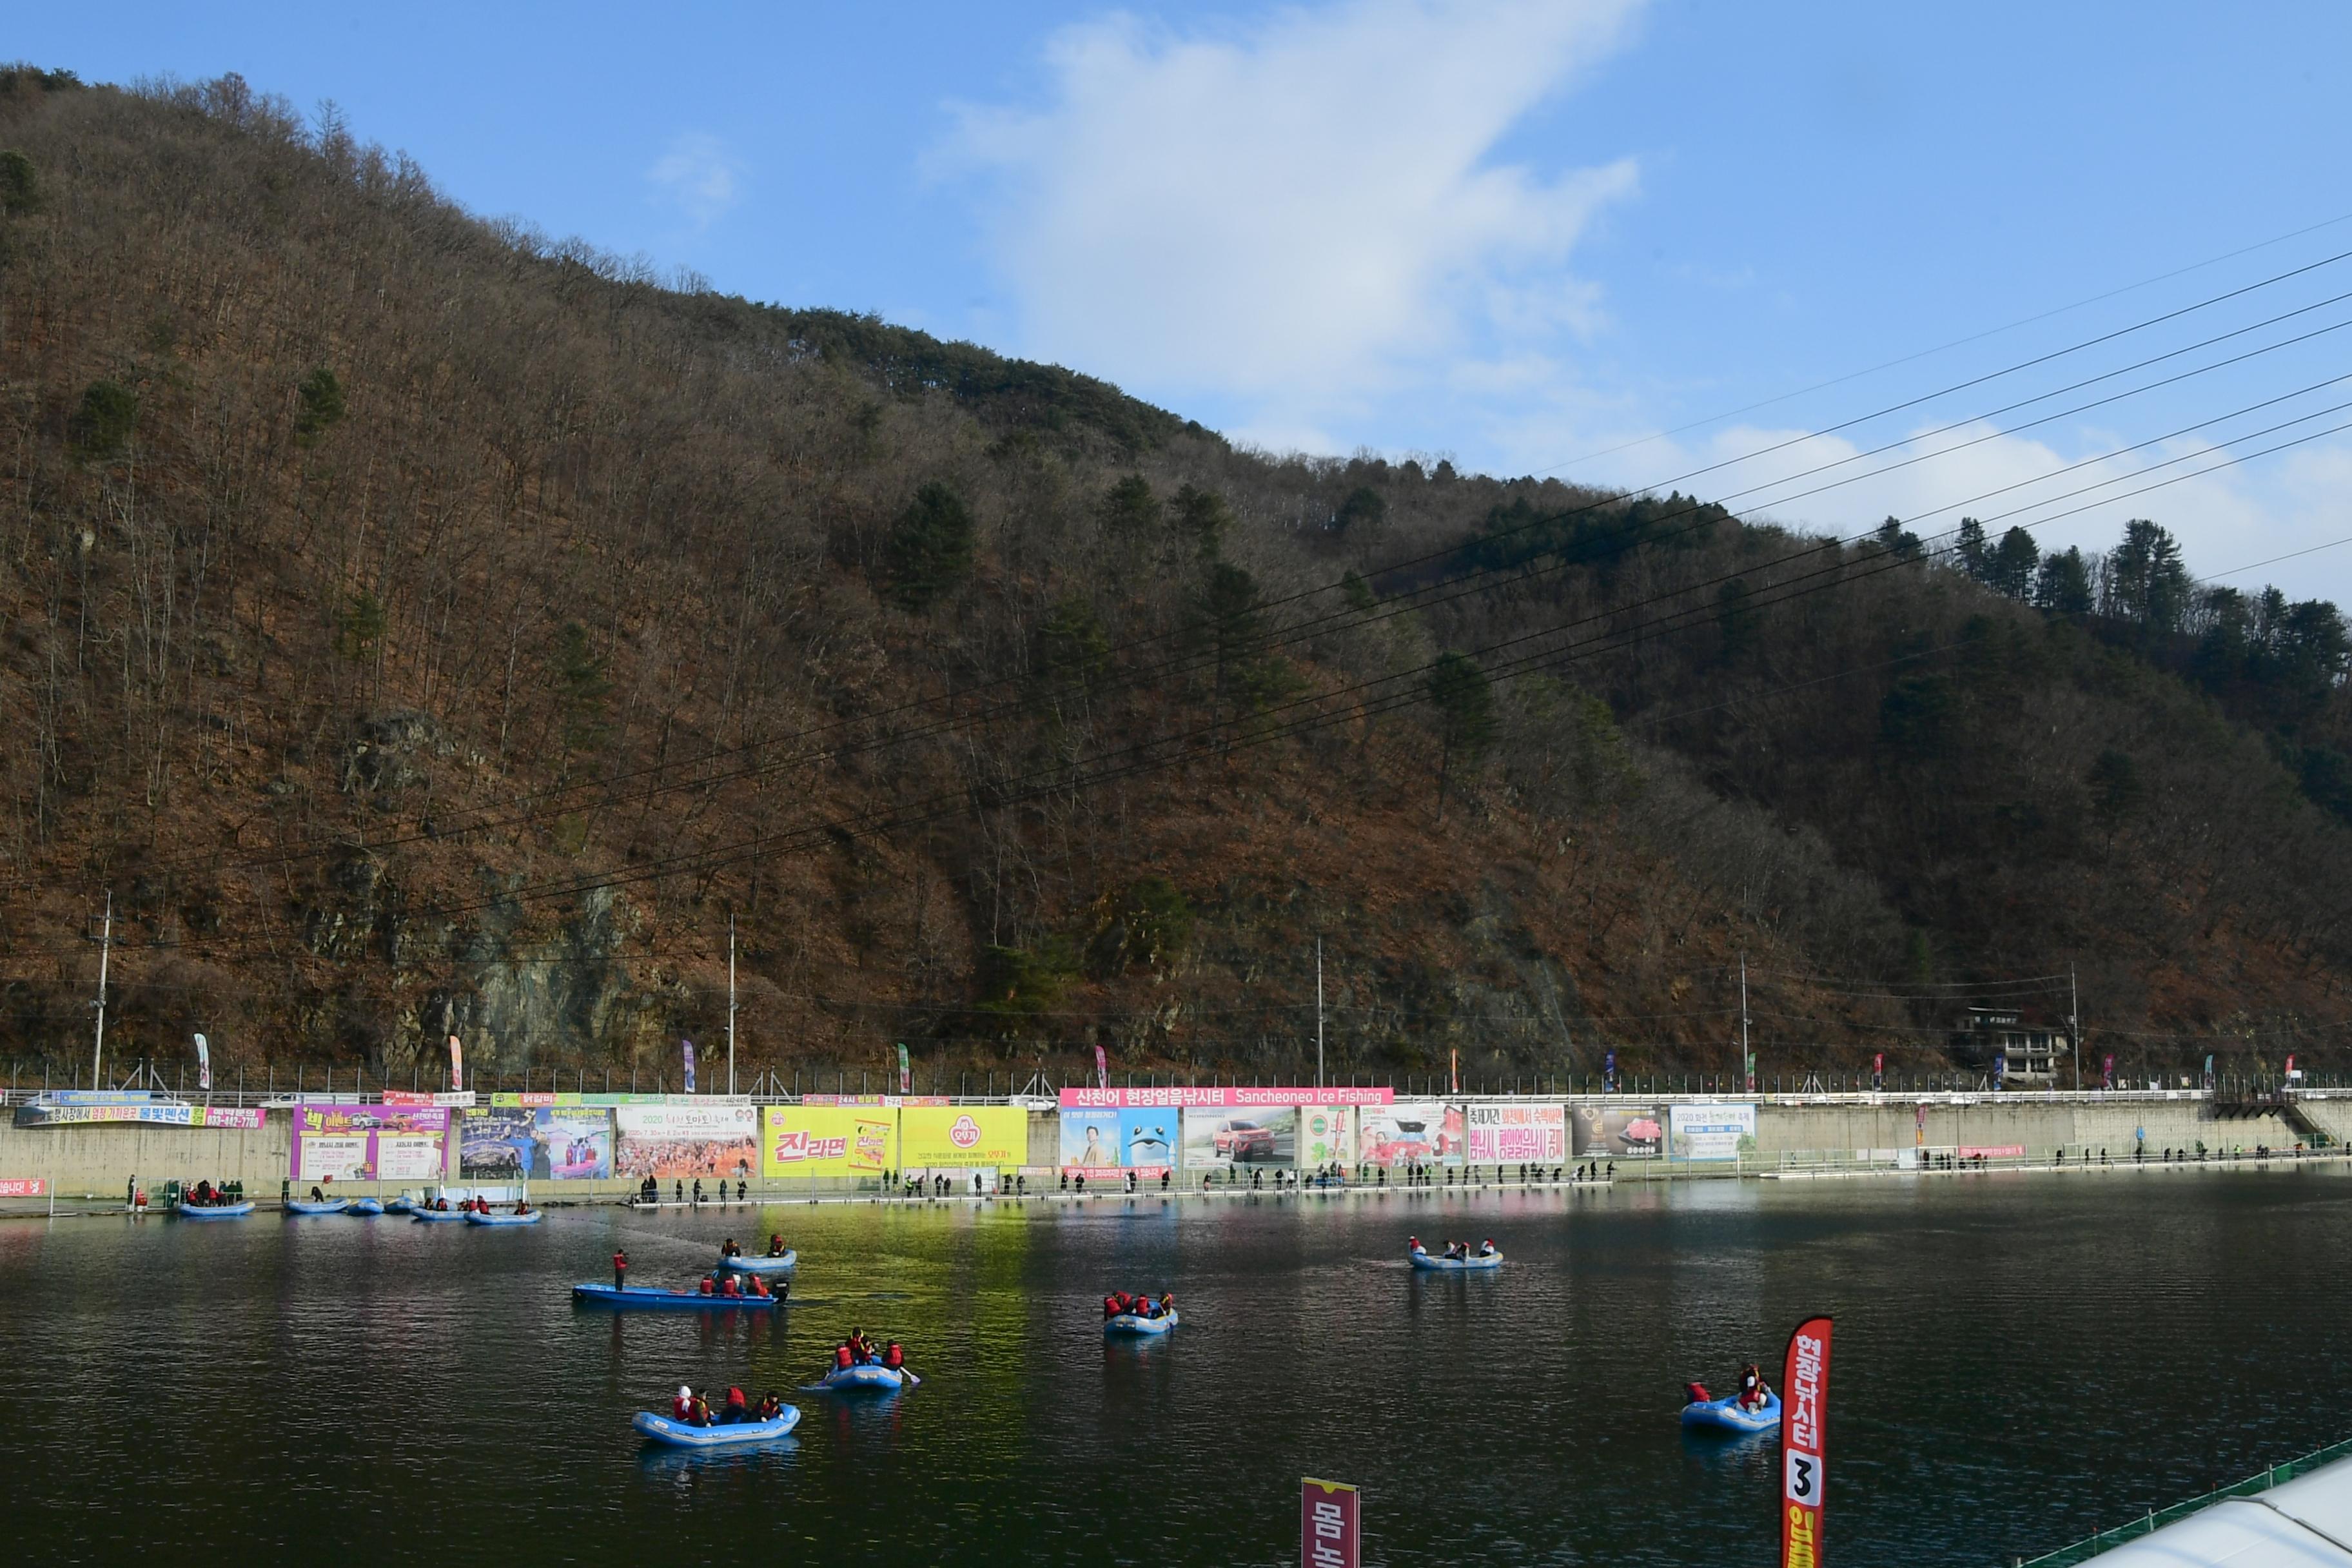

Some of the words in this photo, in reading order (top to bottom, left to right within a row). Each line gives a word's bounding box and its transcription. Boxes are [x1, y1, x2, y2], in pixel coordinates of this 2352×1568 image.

[838, 1095, 855, 1104] 24시
[1076, 1088, 1120, 1106] 산천어
[1126, 1088, 1224, 1106] 현장얼음낚시터
[1235, 1089, 1313, 1103] Sancheoneo
[1317, 1089, 1335, 1103] Ice
[1338, 1089, 1382, 1104] Fishing
[54, 1108, 90, 1122] 행사장에서
[92, 1108, 106, 1120] 엄청
[307, 1110, 325, 1130] 빅
[643, 1115, 663, 1124] 2020
[1469, 1108, 1500, 1125] 축제기간
[1502, 1108, 1532, 1125] 화천에서
[1534, 1108, 1563, 1124] 숙박하면
[1677, 1113, 1694, 1122] 2020
[954, 1130, 976, 1141] 오뚜기
[1548, 1129, 1563, 1159] 공짜
[775, 1131, 847, 1162] 진라면
[1792, 1334, 1822, 1449] 현장낚시터
[1794, 1458, 1812, 1497] 3
